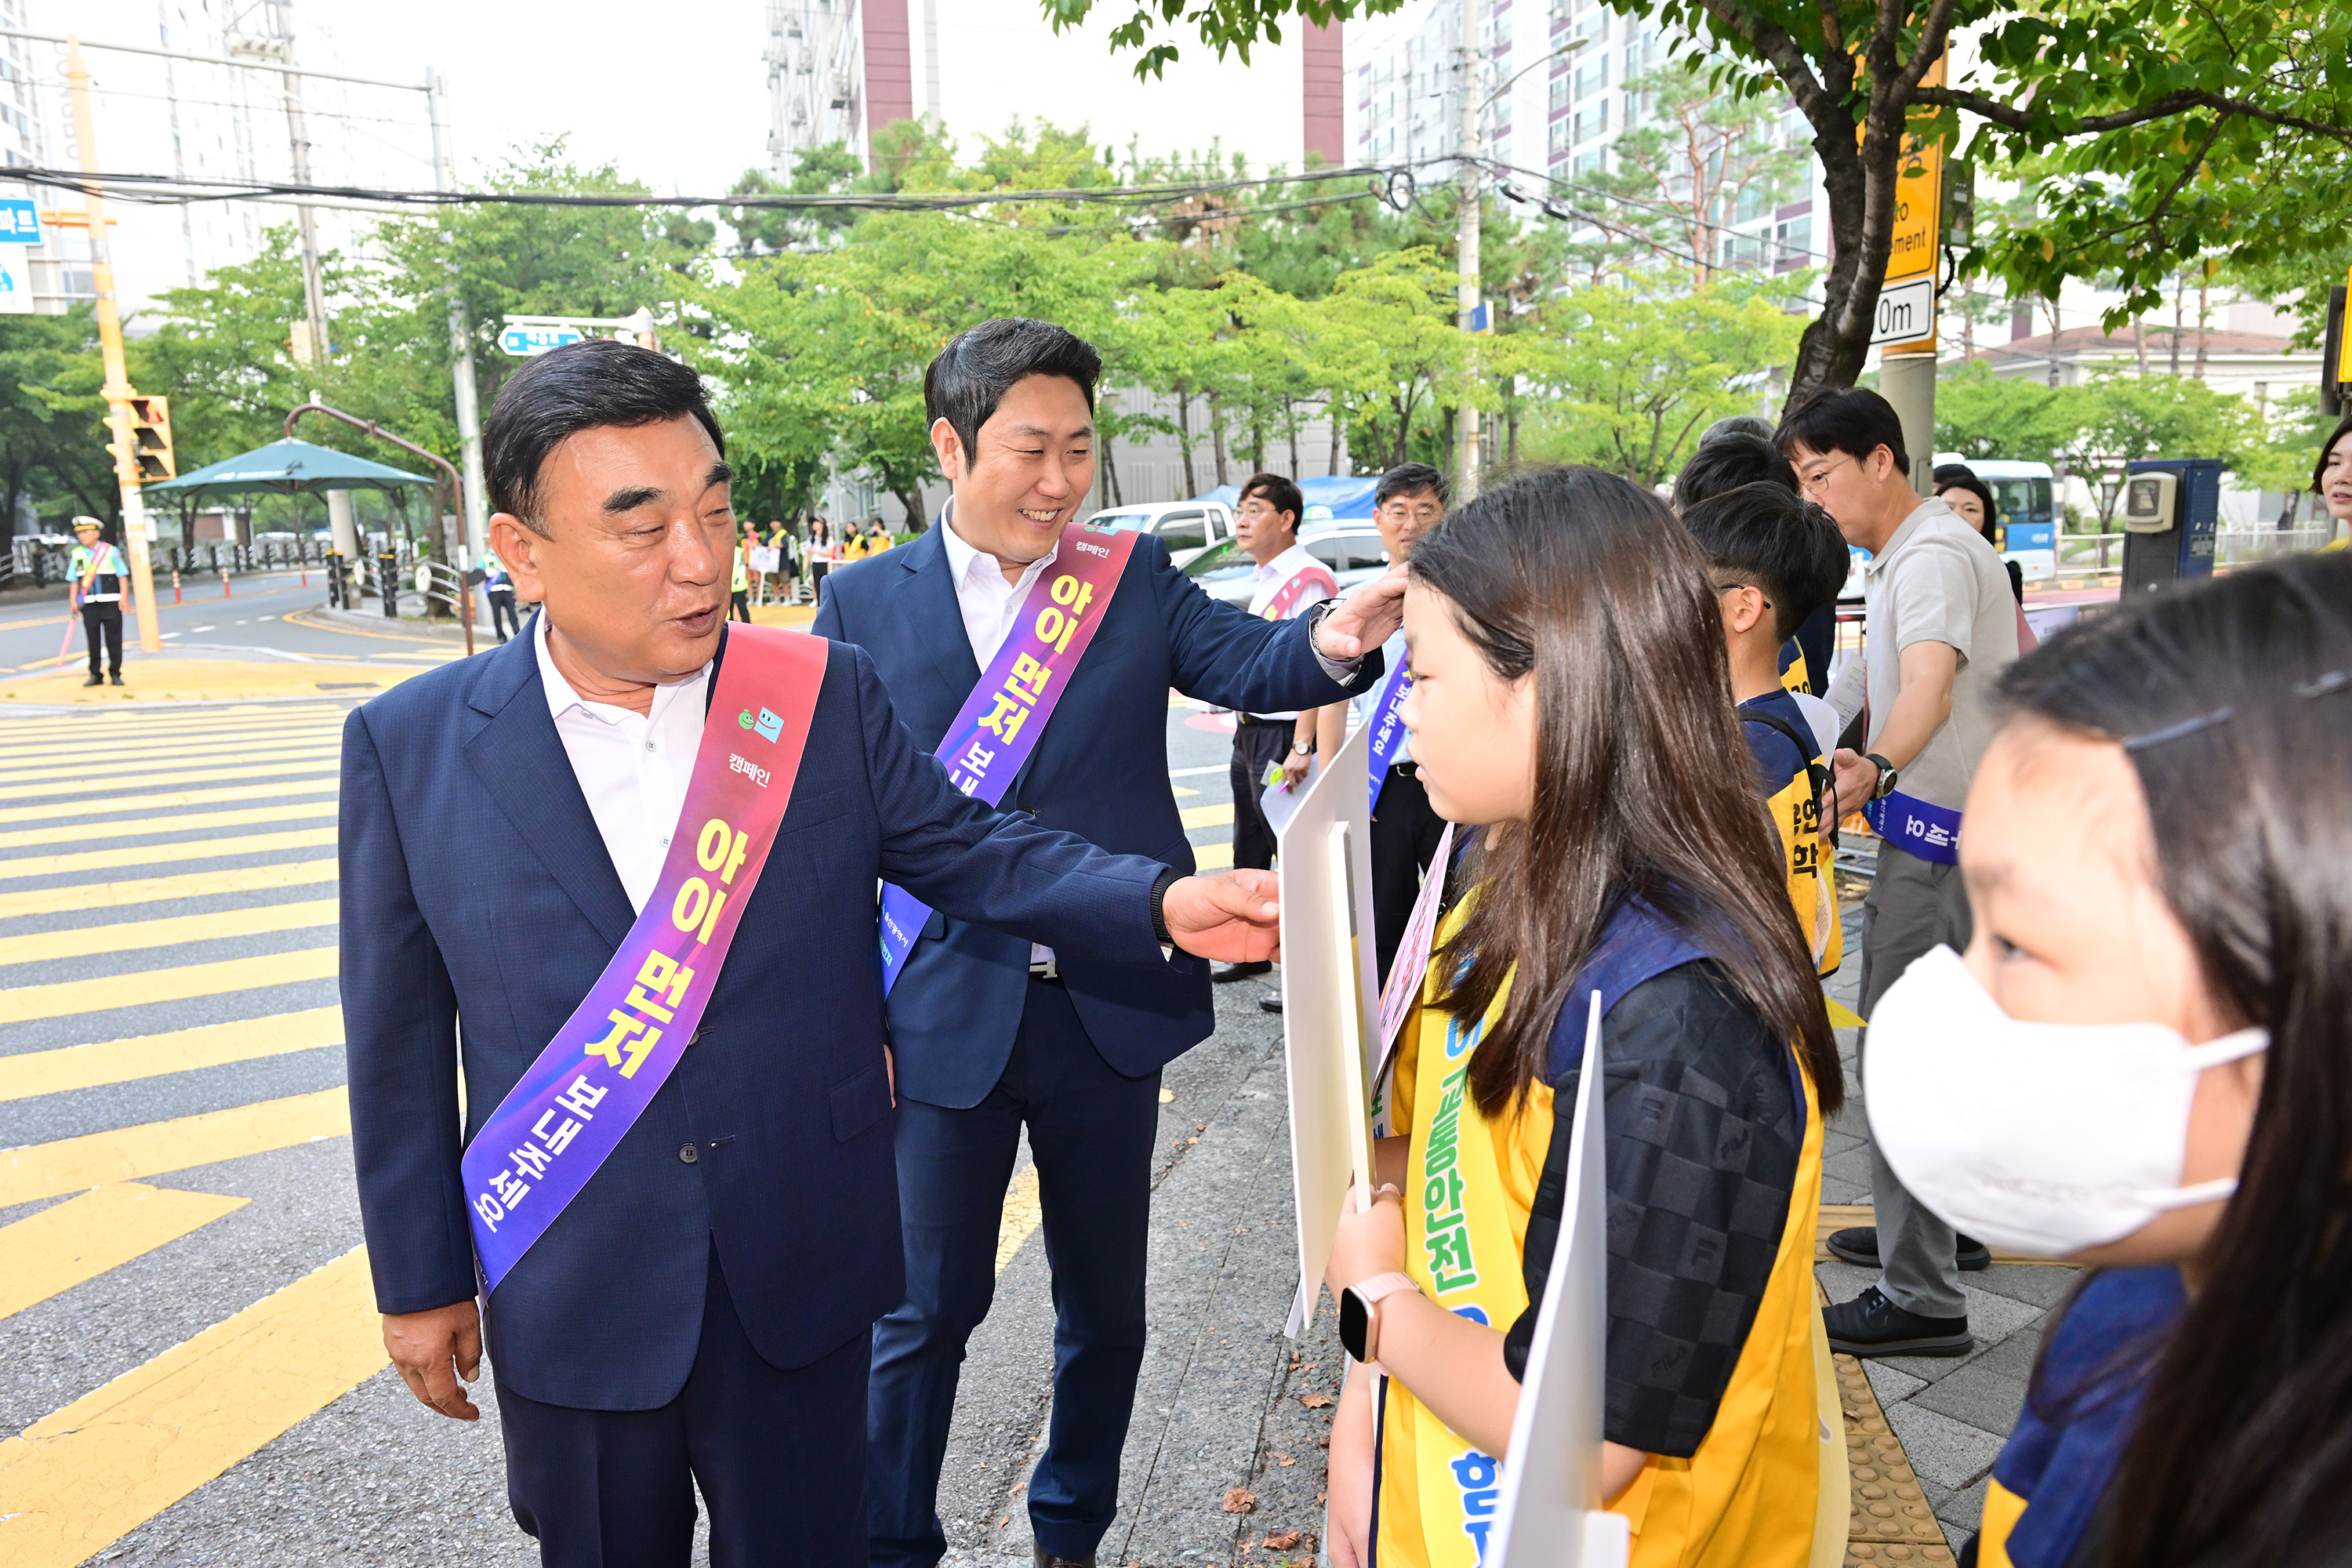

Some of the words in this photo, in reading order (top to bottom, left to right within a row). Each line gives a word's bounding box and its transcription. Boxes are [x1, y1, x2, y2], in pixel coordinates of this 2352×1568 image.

[1075, 541, 1110, 559] 캠페인
[1035, 575, 1094, 655] 아이
[977, 651, 1053, 746] 먼저
[728, 753, 771, 789] 캠페인
[671, 818, 750, 946] 아이
[884, 912, 909, 948] 울산광역시
[584, 949, 695, 1080] 먼저
[473, 1074, 609, 1233] 보내주세요
